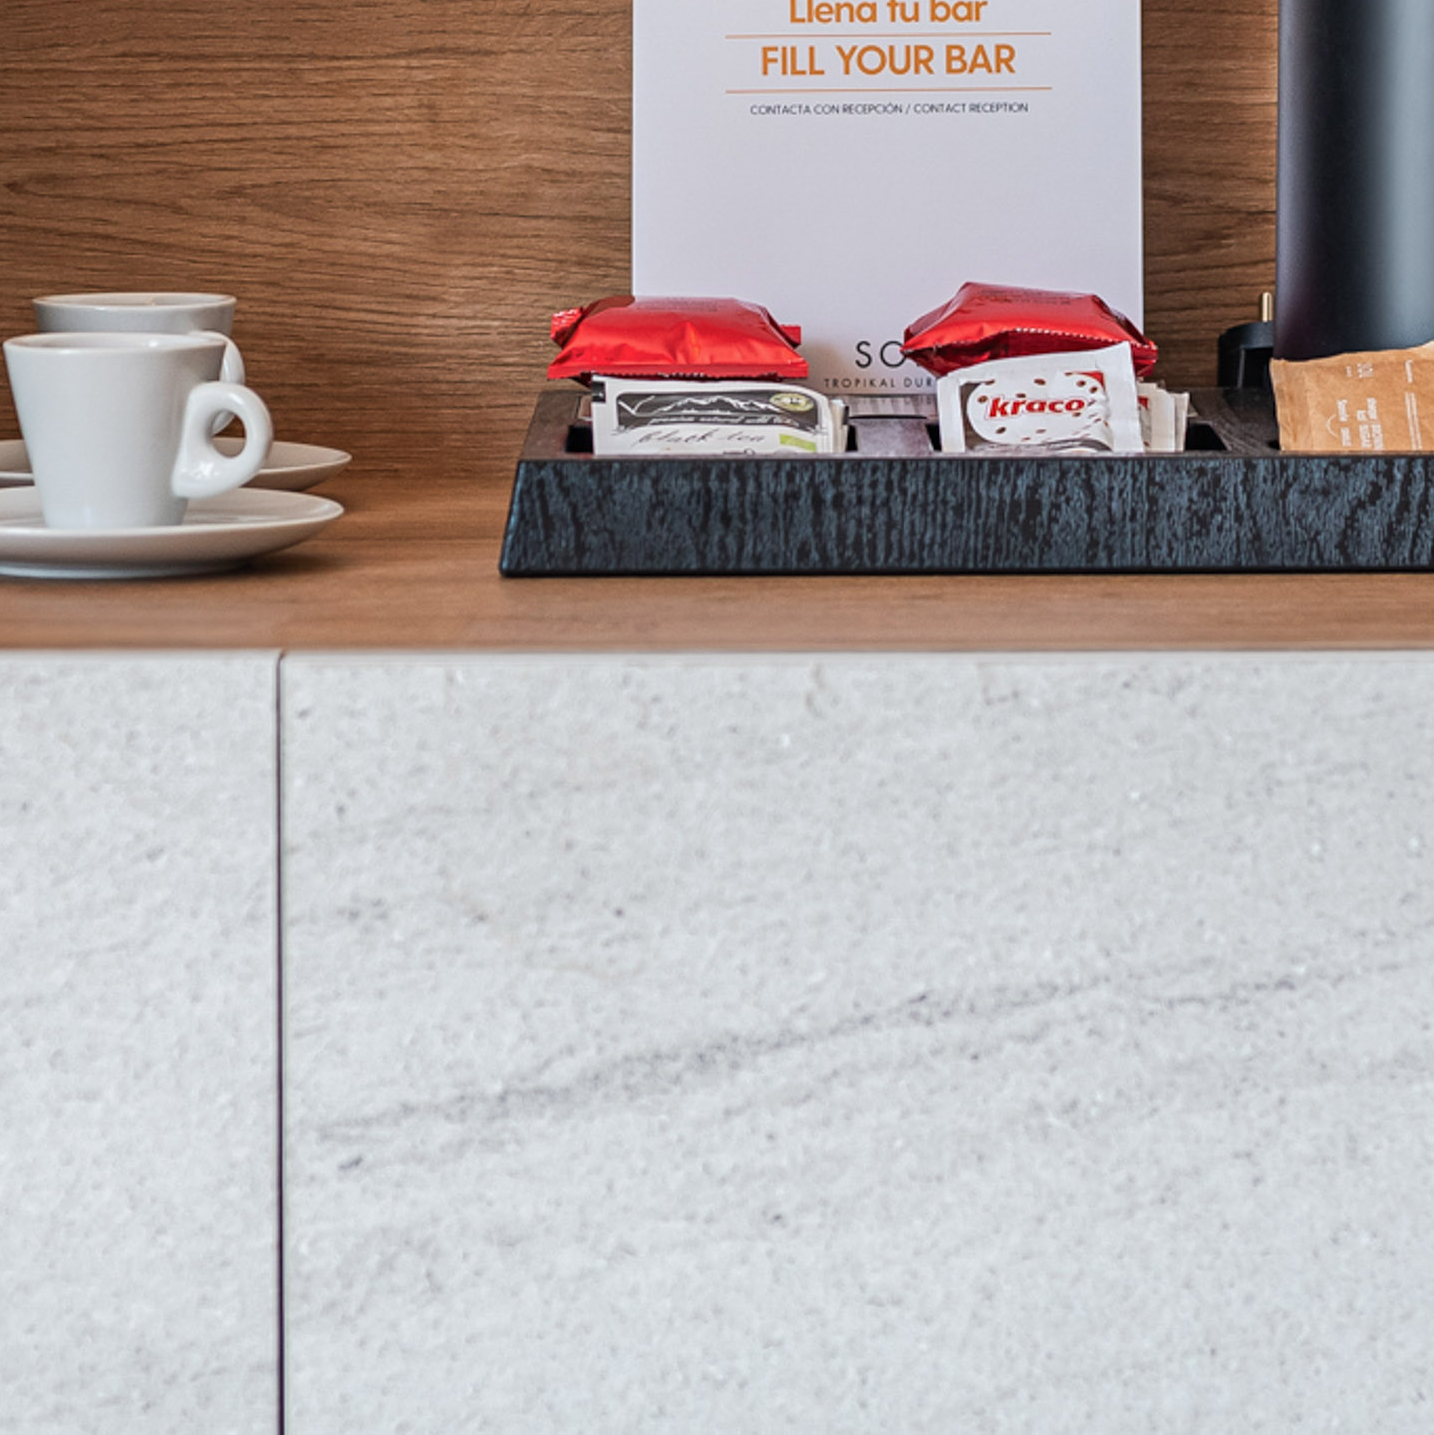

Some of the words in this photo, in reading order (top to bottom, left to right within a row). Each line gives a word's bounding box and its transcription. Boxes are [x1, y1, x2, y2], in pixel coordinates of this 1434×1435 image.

[762, 46, 825, 76] FILL
[836, 45, 934, 75] YOUR
[945, 44, 1016, 74] BAR
[750, 104, 811, 115] CONTACTA
[814, 104, 839, 115] CON
[842, 101, 902, 115] RECEPCIÓN
[914, 103, 966, 114] CONTACT
[969, 102, 1028, 113] RECEPTION
[855, 341, 906, 368] SO
[824, 378, 896, 388] TROPIKAL
[988, 396, 1085, 417] kraco
